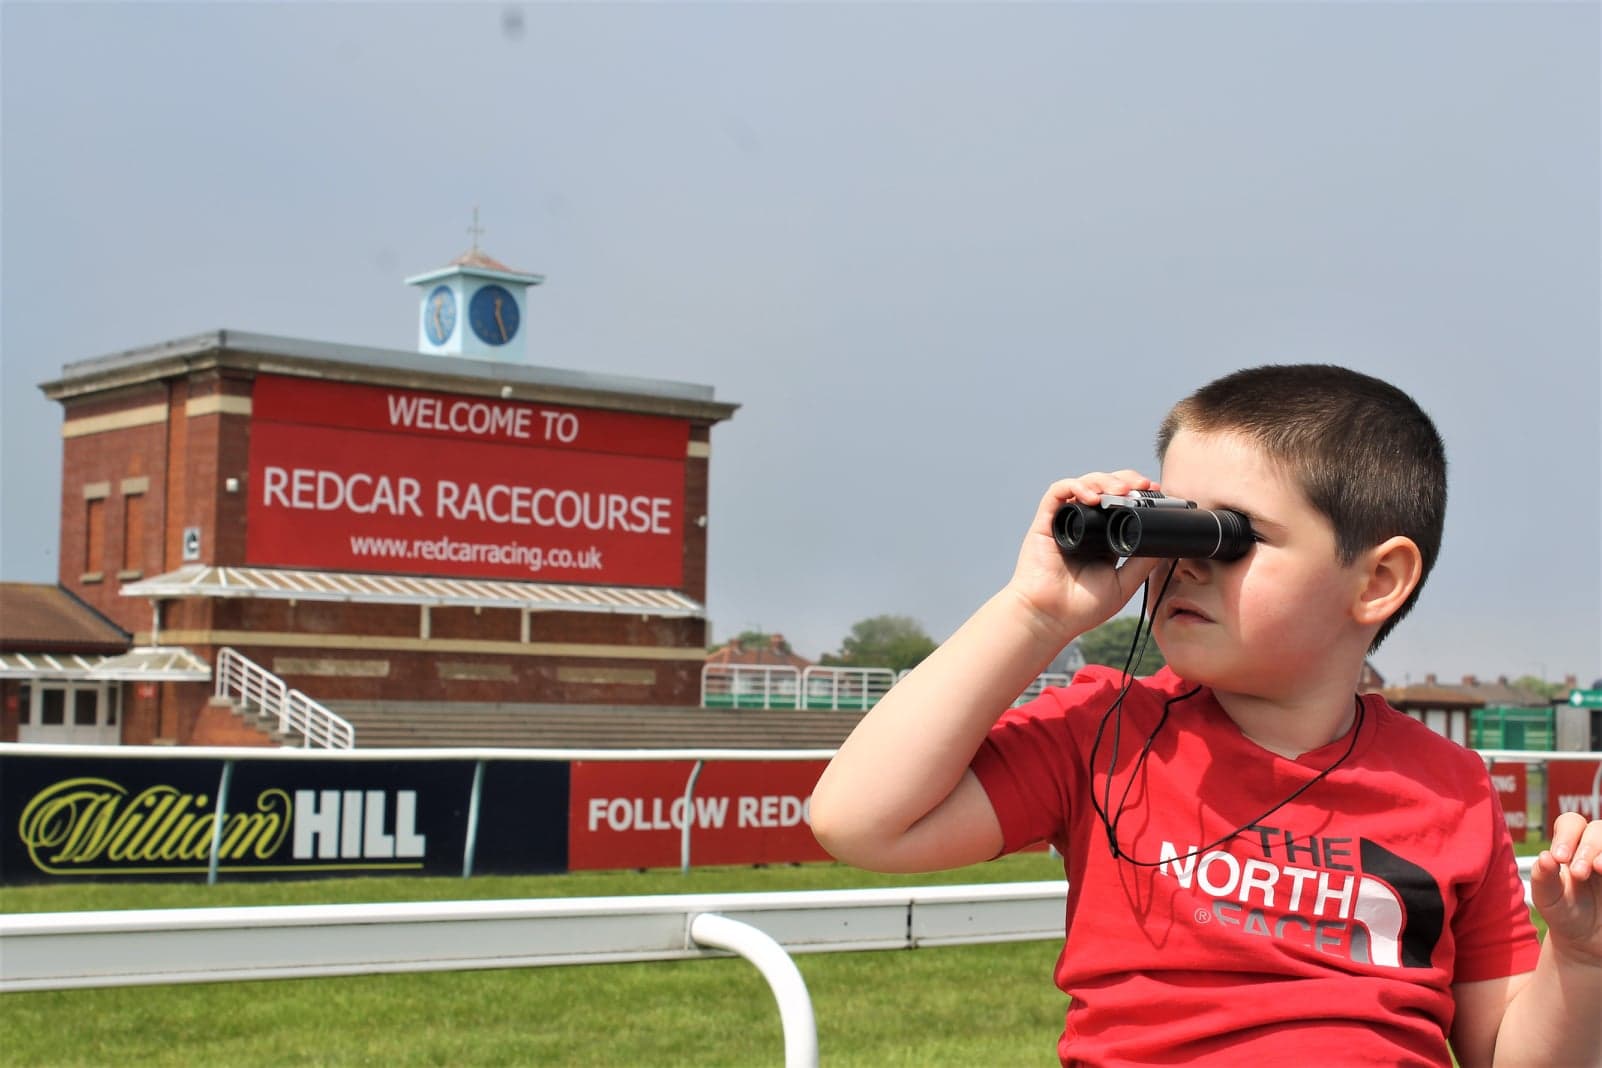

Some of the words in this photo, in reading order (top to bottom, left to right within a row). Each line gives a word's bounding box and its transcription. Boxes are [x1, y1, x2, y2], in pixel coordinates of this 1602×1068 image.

[387, 394, 532, 438] WELCOME
[541, 410, 579, 442] TO
[263, 466, 423, 517] REDCAR
[436, 480, 671, 534] RACECOURSE
[350, 535, 602, 570] www.redcarracing.co.uk
[19, 778, 293, 864] William
[293, 790, 426, 859] HILL
[588, 796, 729, 831] FOLLOW
[1248, 825, 1354, 871] THE
[1159, 841, 1354, 919] NORTH
